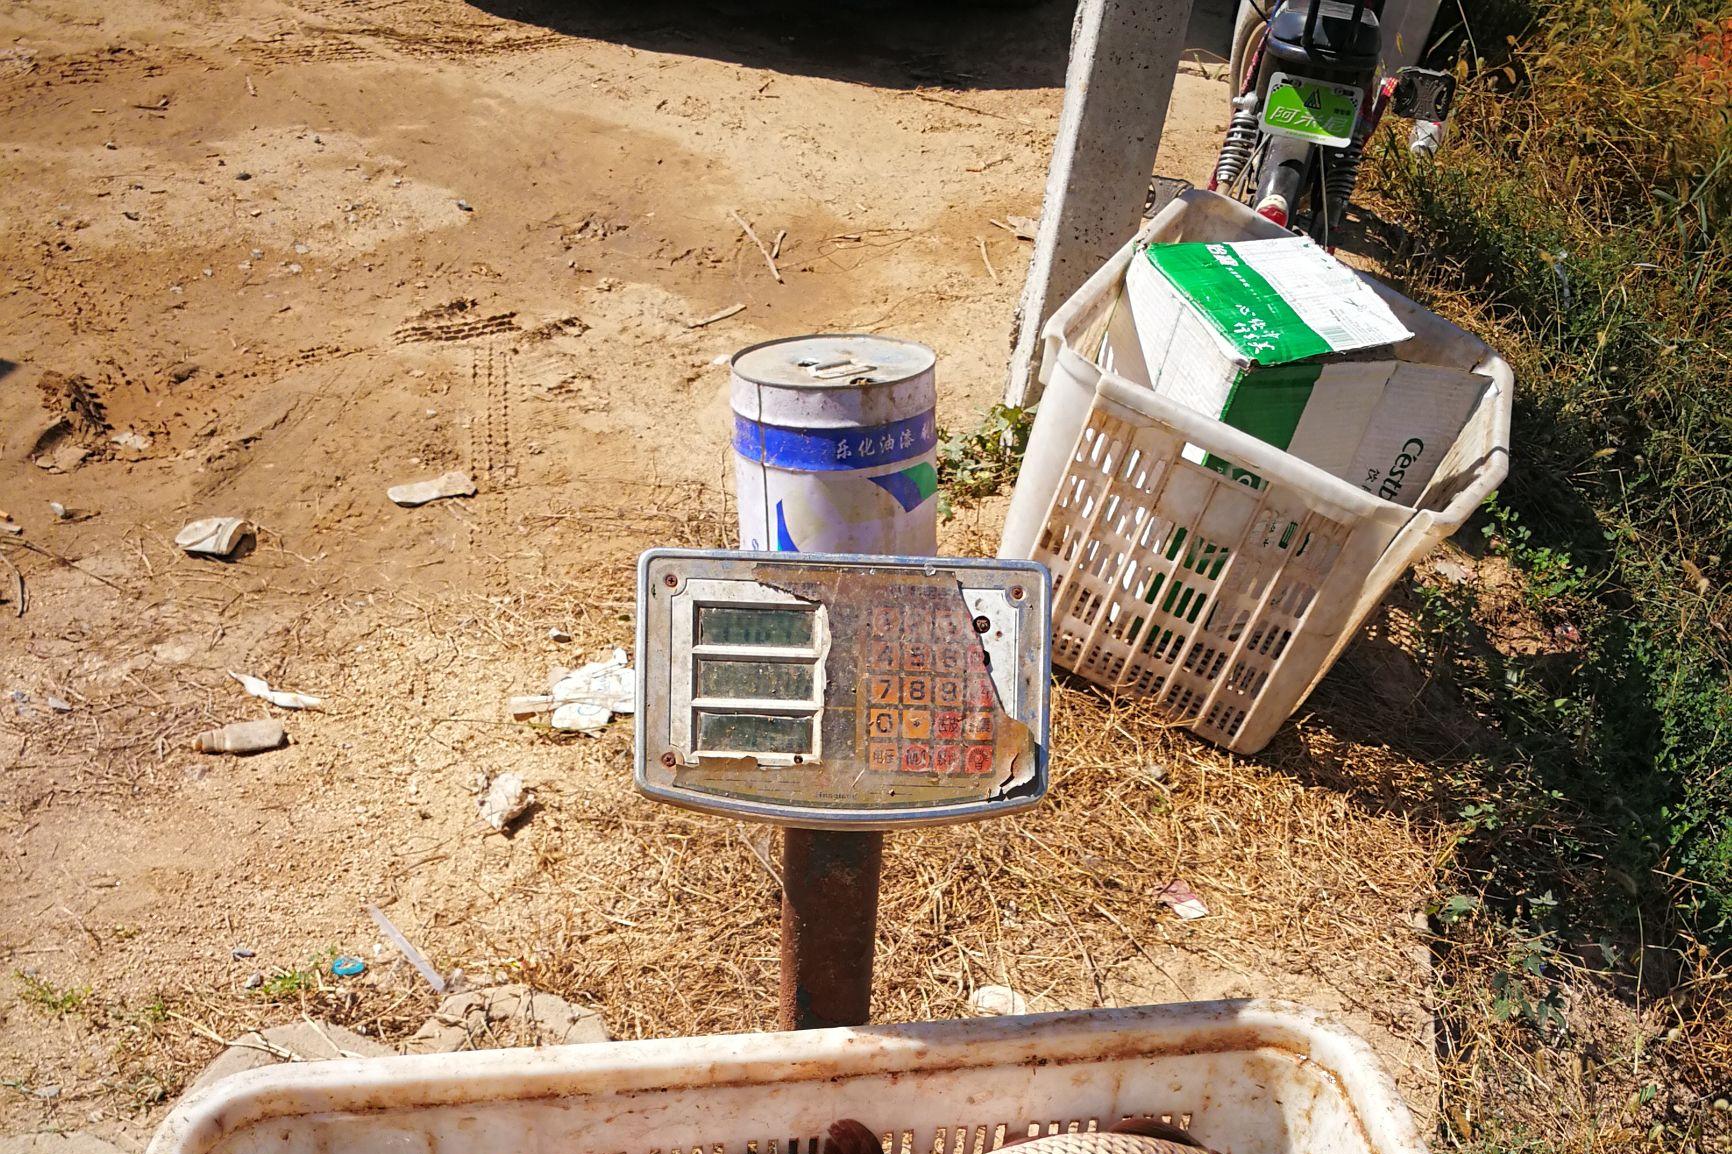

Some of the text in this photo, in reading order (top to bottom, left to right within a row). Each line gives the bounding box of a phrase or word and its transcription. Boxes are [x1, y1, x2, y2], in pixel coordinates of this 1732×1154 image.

[879, 679, 892, 700] 7
[909, 680, 926, 700] 8
[941, 681, 958, 702] 9
[876, 713, 893, 733] 0
